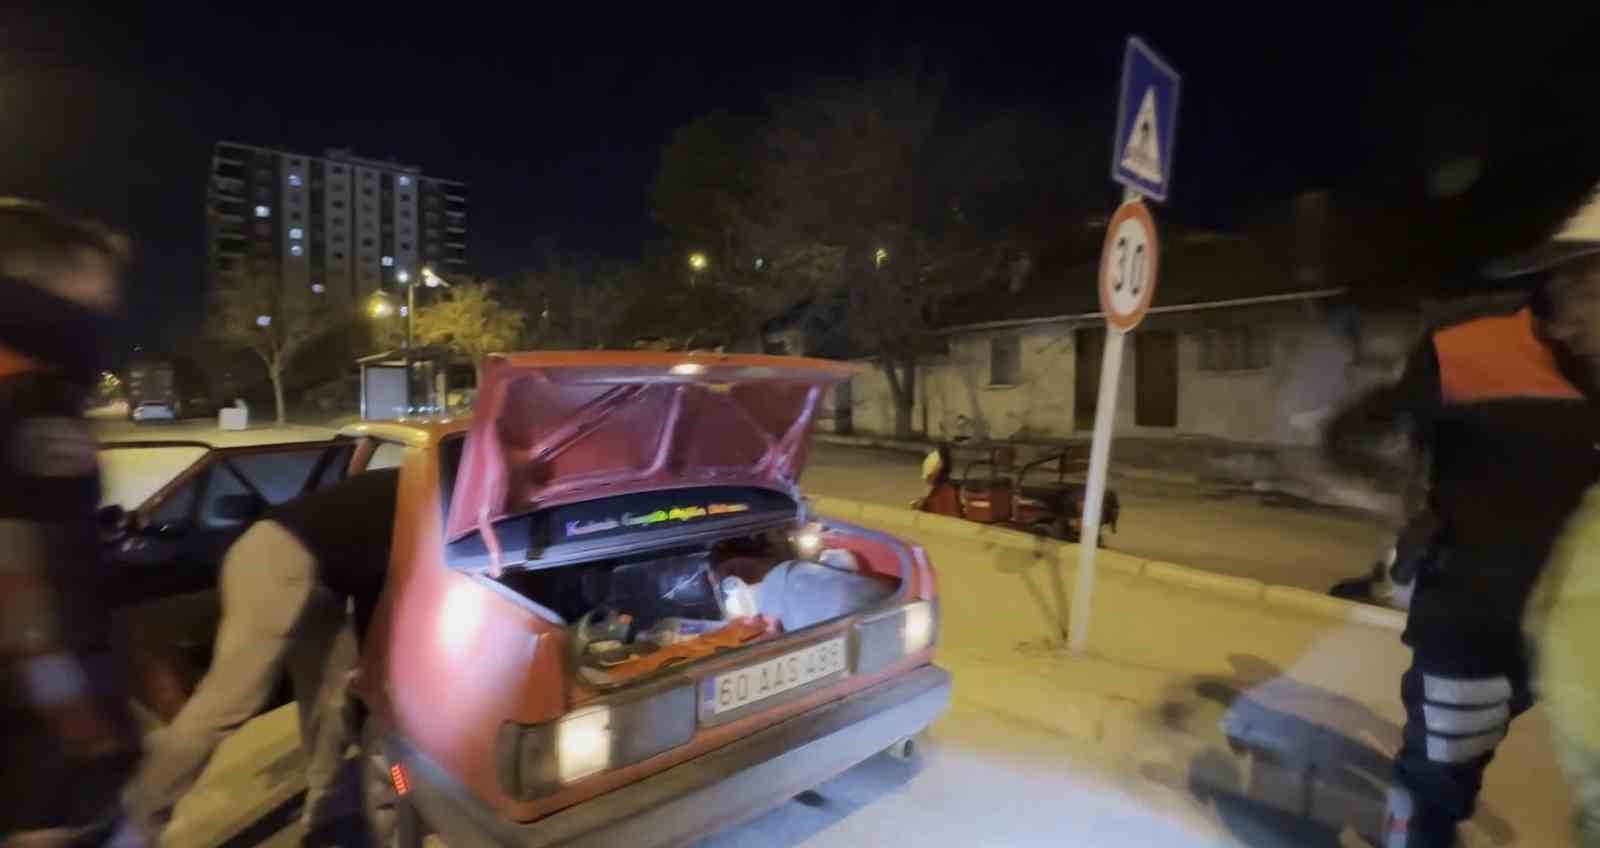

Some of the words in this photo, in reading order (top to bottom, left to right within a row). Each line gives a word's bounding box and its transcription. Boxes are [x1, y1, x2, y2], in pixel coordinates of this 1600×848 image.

[1113, 236, 1146, 296] 30
[718, 672, 749, 706] 60
[758, 656, 800, 691] AAS
